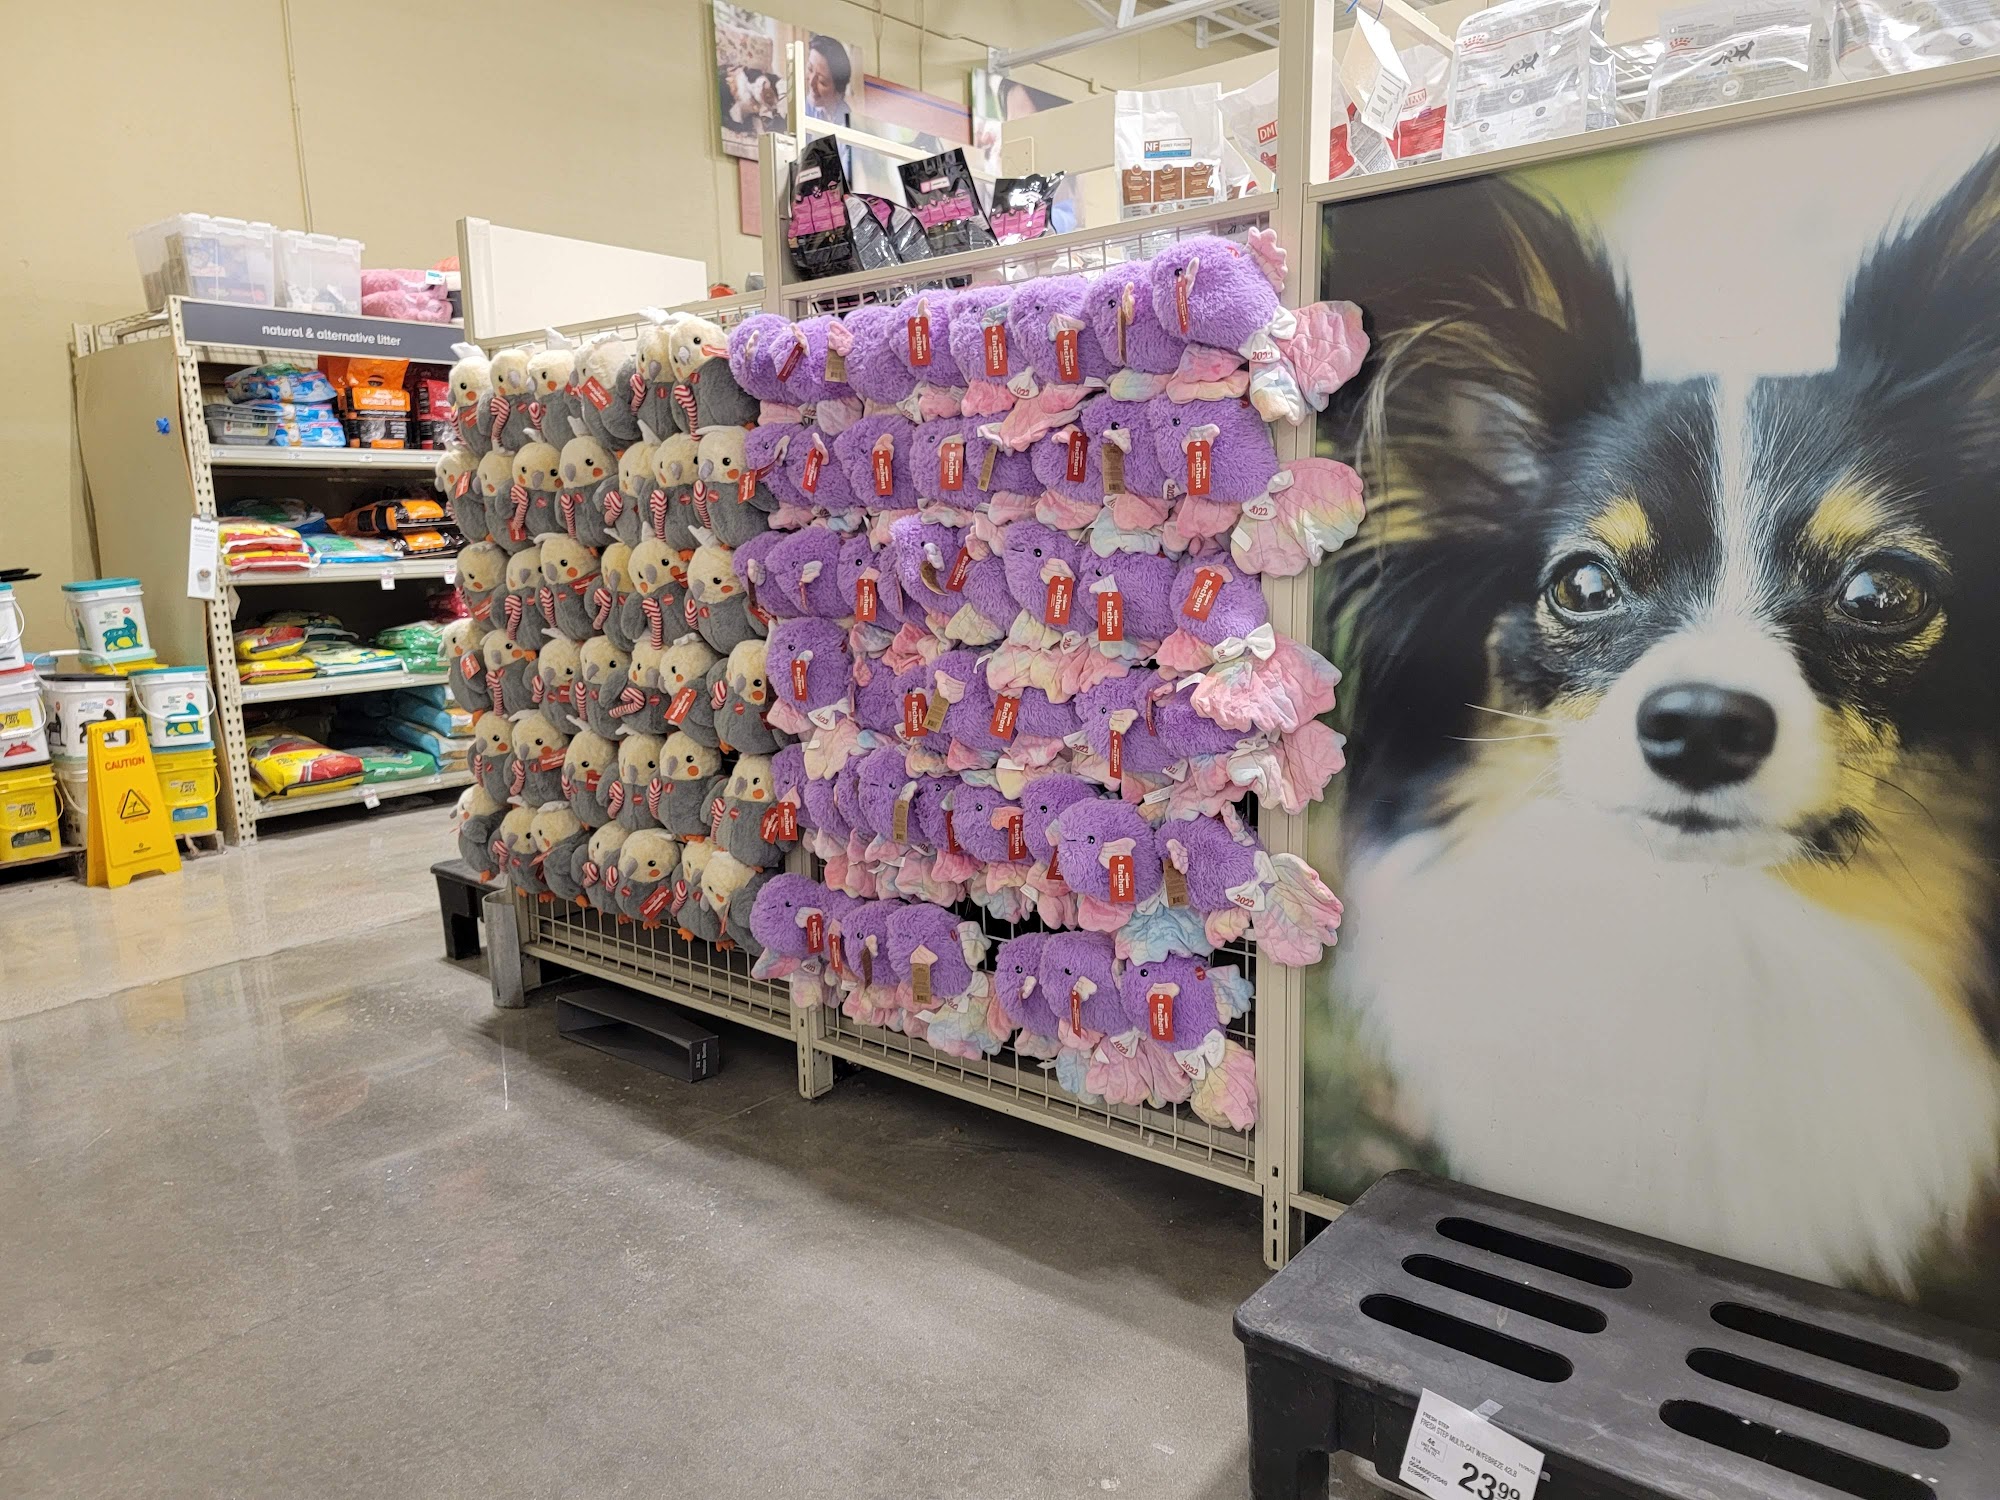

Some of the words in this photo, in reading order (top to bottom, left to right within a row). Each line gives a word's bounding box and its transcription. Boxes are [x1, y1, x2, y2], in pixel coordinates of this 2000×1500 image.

[1145, 142, 1160, 152] NF
[1259, 124, 1276, 141] DM
[262, 325, 304, 339] natural
[305, 327, 315, 339] &
[316, 329, 376, 345] alternative
[377, 334, 401, 347] litter
[915, 325, 923, 360] Enchant
[991, 333, 999, 370] Enchant
[1063, 338, 1072, 376] Enchant
[1251, 349, 1274, 361] 2022
[879, 458, 887, 490] Enchant
[948, 451, 956, 484] Enchant
[1072, 440, 1081, 476] Enchant
[1195, 451, 1203, 490] Enchant
[953, 556, 968, 586] Enchant
[862, 586, 870, 616] Enchant
[1054, 584, 1065, 619] Enchant
[1193, 578, 1213, 612] Enchant
[1106, 601, 1114, 637] Enchant
[997, 702, 1011, 733] Enchant
[105, 755, 146, 771] CAUTION
[1013, 823, 1021, 855] Enchant
[1117, 864, 1126, 898] Enchant
[1234, 893, 1255, 909] 2022
[1157, 1003, 1166, 1036] Enchant
[1182, 1061, 1199, 1077] 2022
[1420, 1417, 1437, 1433] FRESH
[1436, 1427, 1450, 1439] STEP
[1449, 1434, 1476, 1454] MULTI-CAT
[1422, 1411, 1438, 1423] FRESH
[1438, 1420, 1450, 1430] STEP
